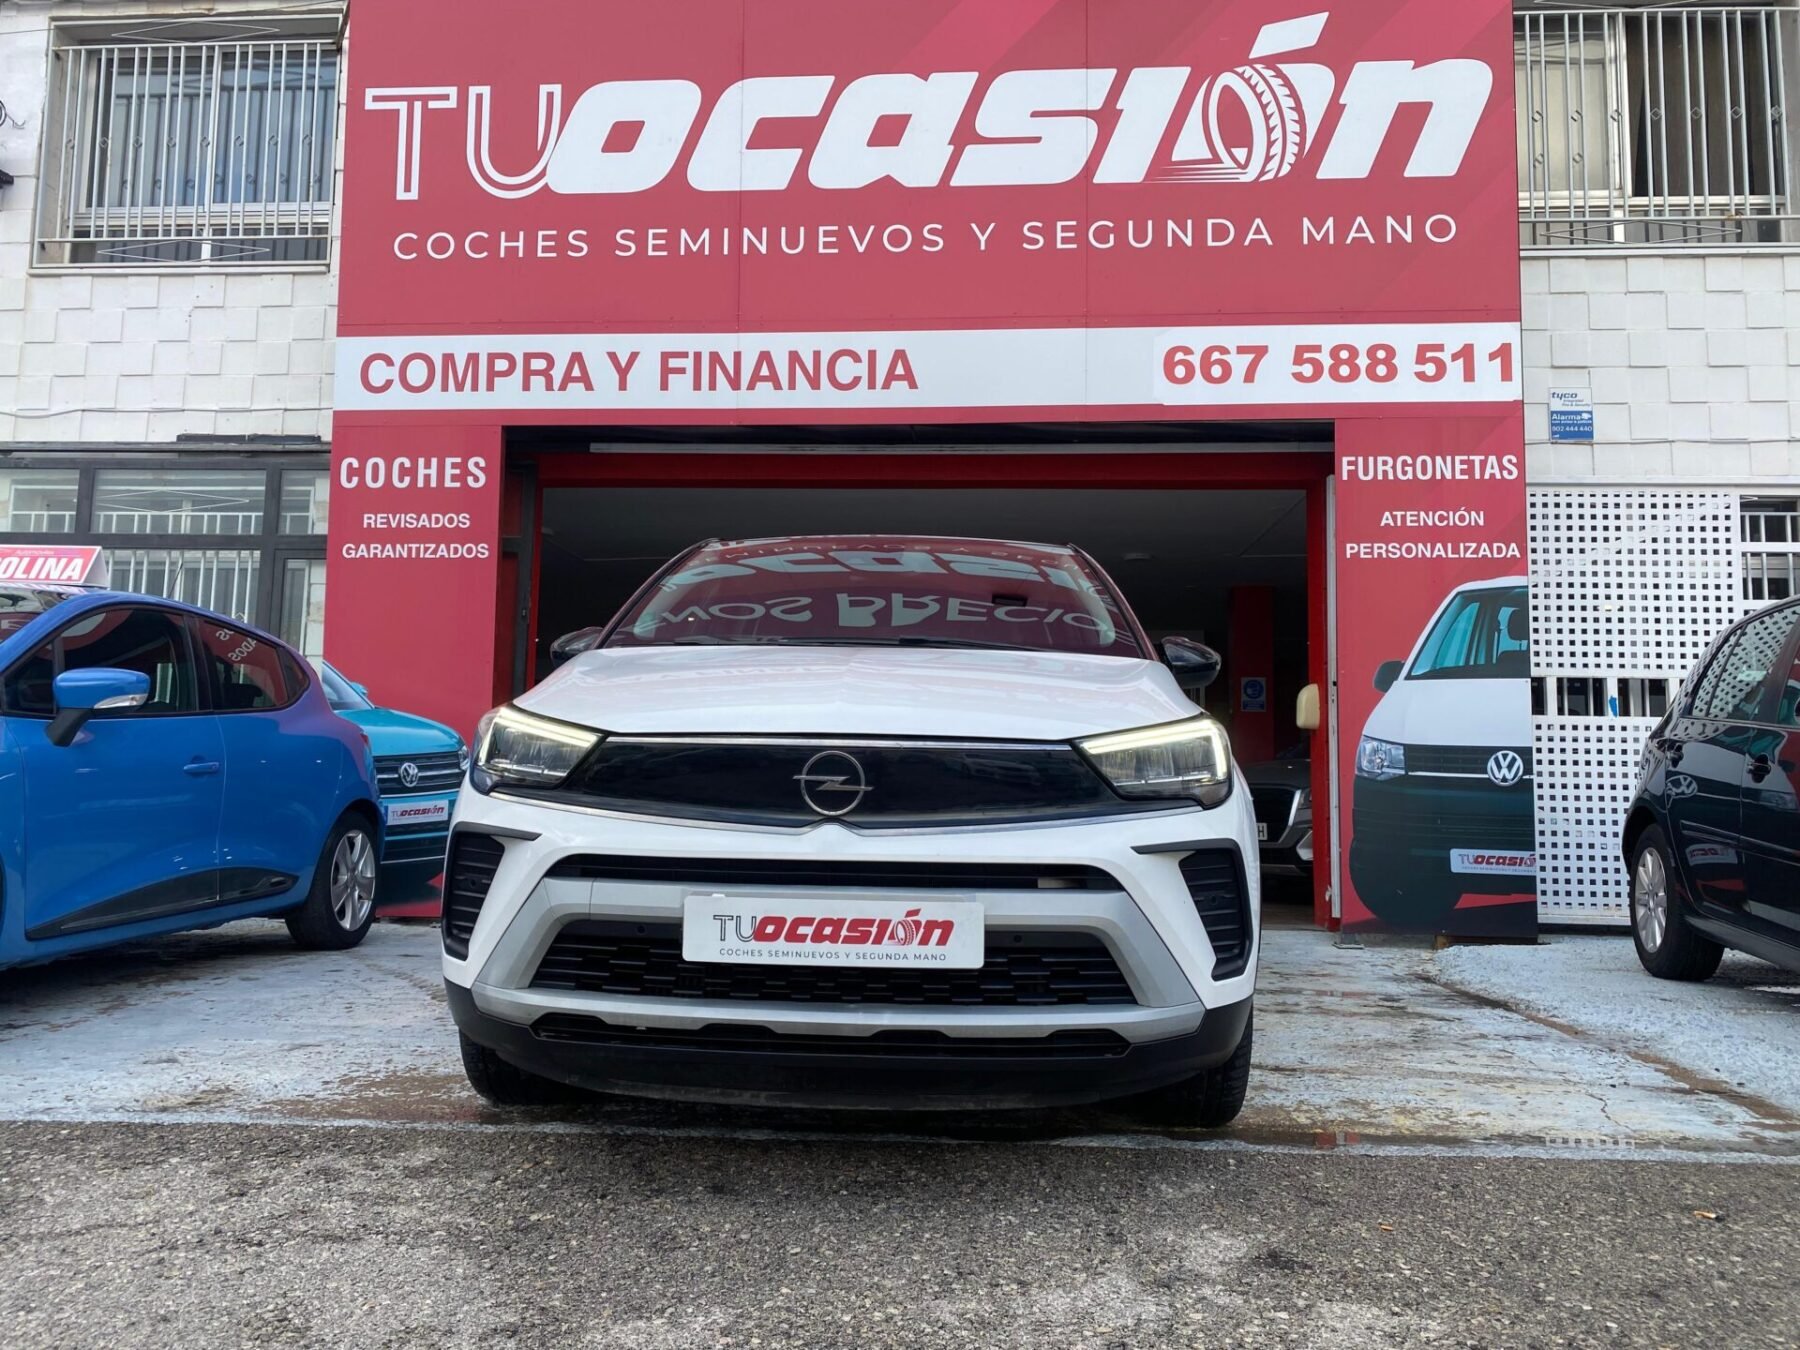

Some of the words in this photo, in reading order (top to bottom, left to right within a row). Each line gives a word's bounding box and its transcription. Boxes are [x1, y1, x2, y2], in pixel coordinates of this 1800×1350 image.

[393, 229, 589, 260] COCHES
[614, 223, 944, 257] SEMINUEVOS
[970, 222, 996, 251] Y
[1022, 217, 1273, 250] SEGUNDA
[1302, 213, 1457, 245] MANO
[359, 351, 595, 393] COMPRA
[605, 350, 640, 391] Y
[659, 348, 919, 391] FINANCIA
[1163, 344, 1269, 385] 667
[1291, 342, 1398, 384] 588
[1413, 341, 1514, 383] 511
[1551, 391, 1578, 401] tyco
[340, 456, 487, 489] COCHES
[1341, 454, 1519, 481] FURGONETAS
[362, 512, 471, 529] REVISADOS
[1380, 506, 1484, 527] ATENCIÓN
[342, 543, 490, 559] GARANTIZADOS
[1345, 542, 1521, 559] PERSONALIZADA
[0, 556, 85, 581] OLINA
[719, 948, 763, 957] COCHES
[767, 949, 840, 959] SEMINUEVOS
[844, 951, 851, 960] Y
[855, 952, 909, 961] SEGUNDA
[913, 953, 947, 961] MANO
